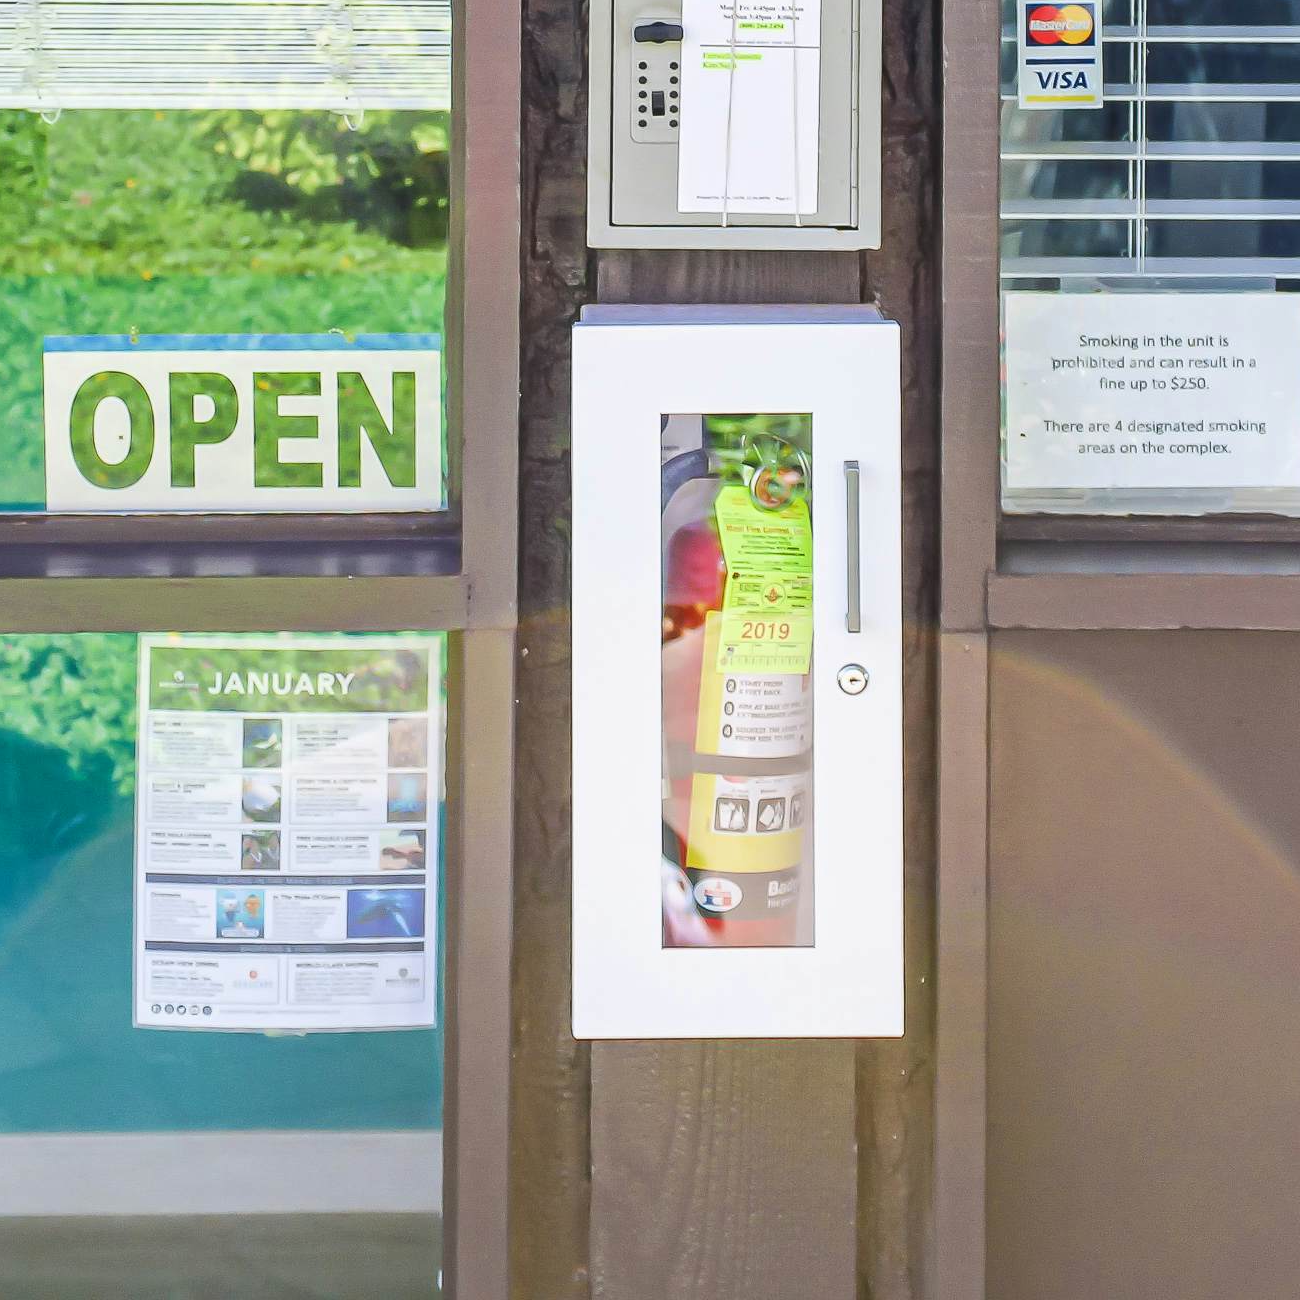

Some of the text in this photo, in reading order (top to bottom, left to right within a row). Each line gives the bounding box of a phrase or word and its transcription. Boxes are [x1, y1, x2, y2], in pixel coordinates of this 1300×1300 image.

[1034, 71, 1088, 89] VISA
[1079, 334, 1229, 349] Smoking in the unit is
[1052, 356, 1256, 371] prohibited and can result in a
[1100, 377, 1210, 392] fine up to $250.
[70, 370, 416, 489] OPEN
[1043, 419, 1266, 435] There are 4 designated smoking
[1078, 441, 1231, 457] areas on the complex.
[741, 622, 790, 639] 2019
[208, 671, 355, 696] JANUARY
